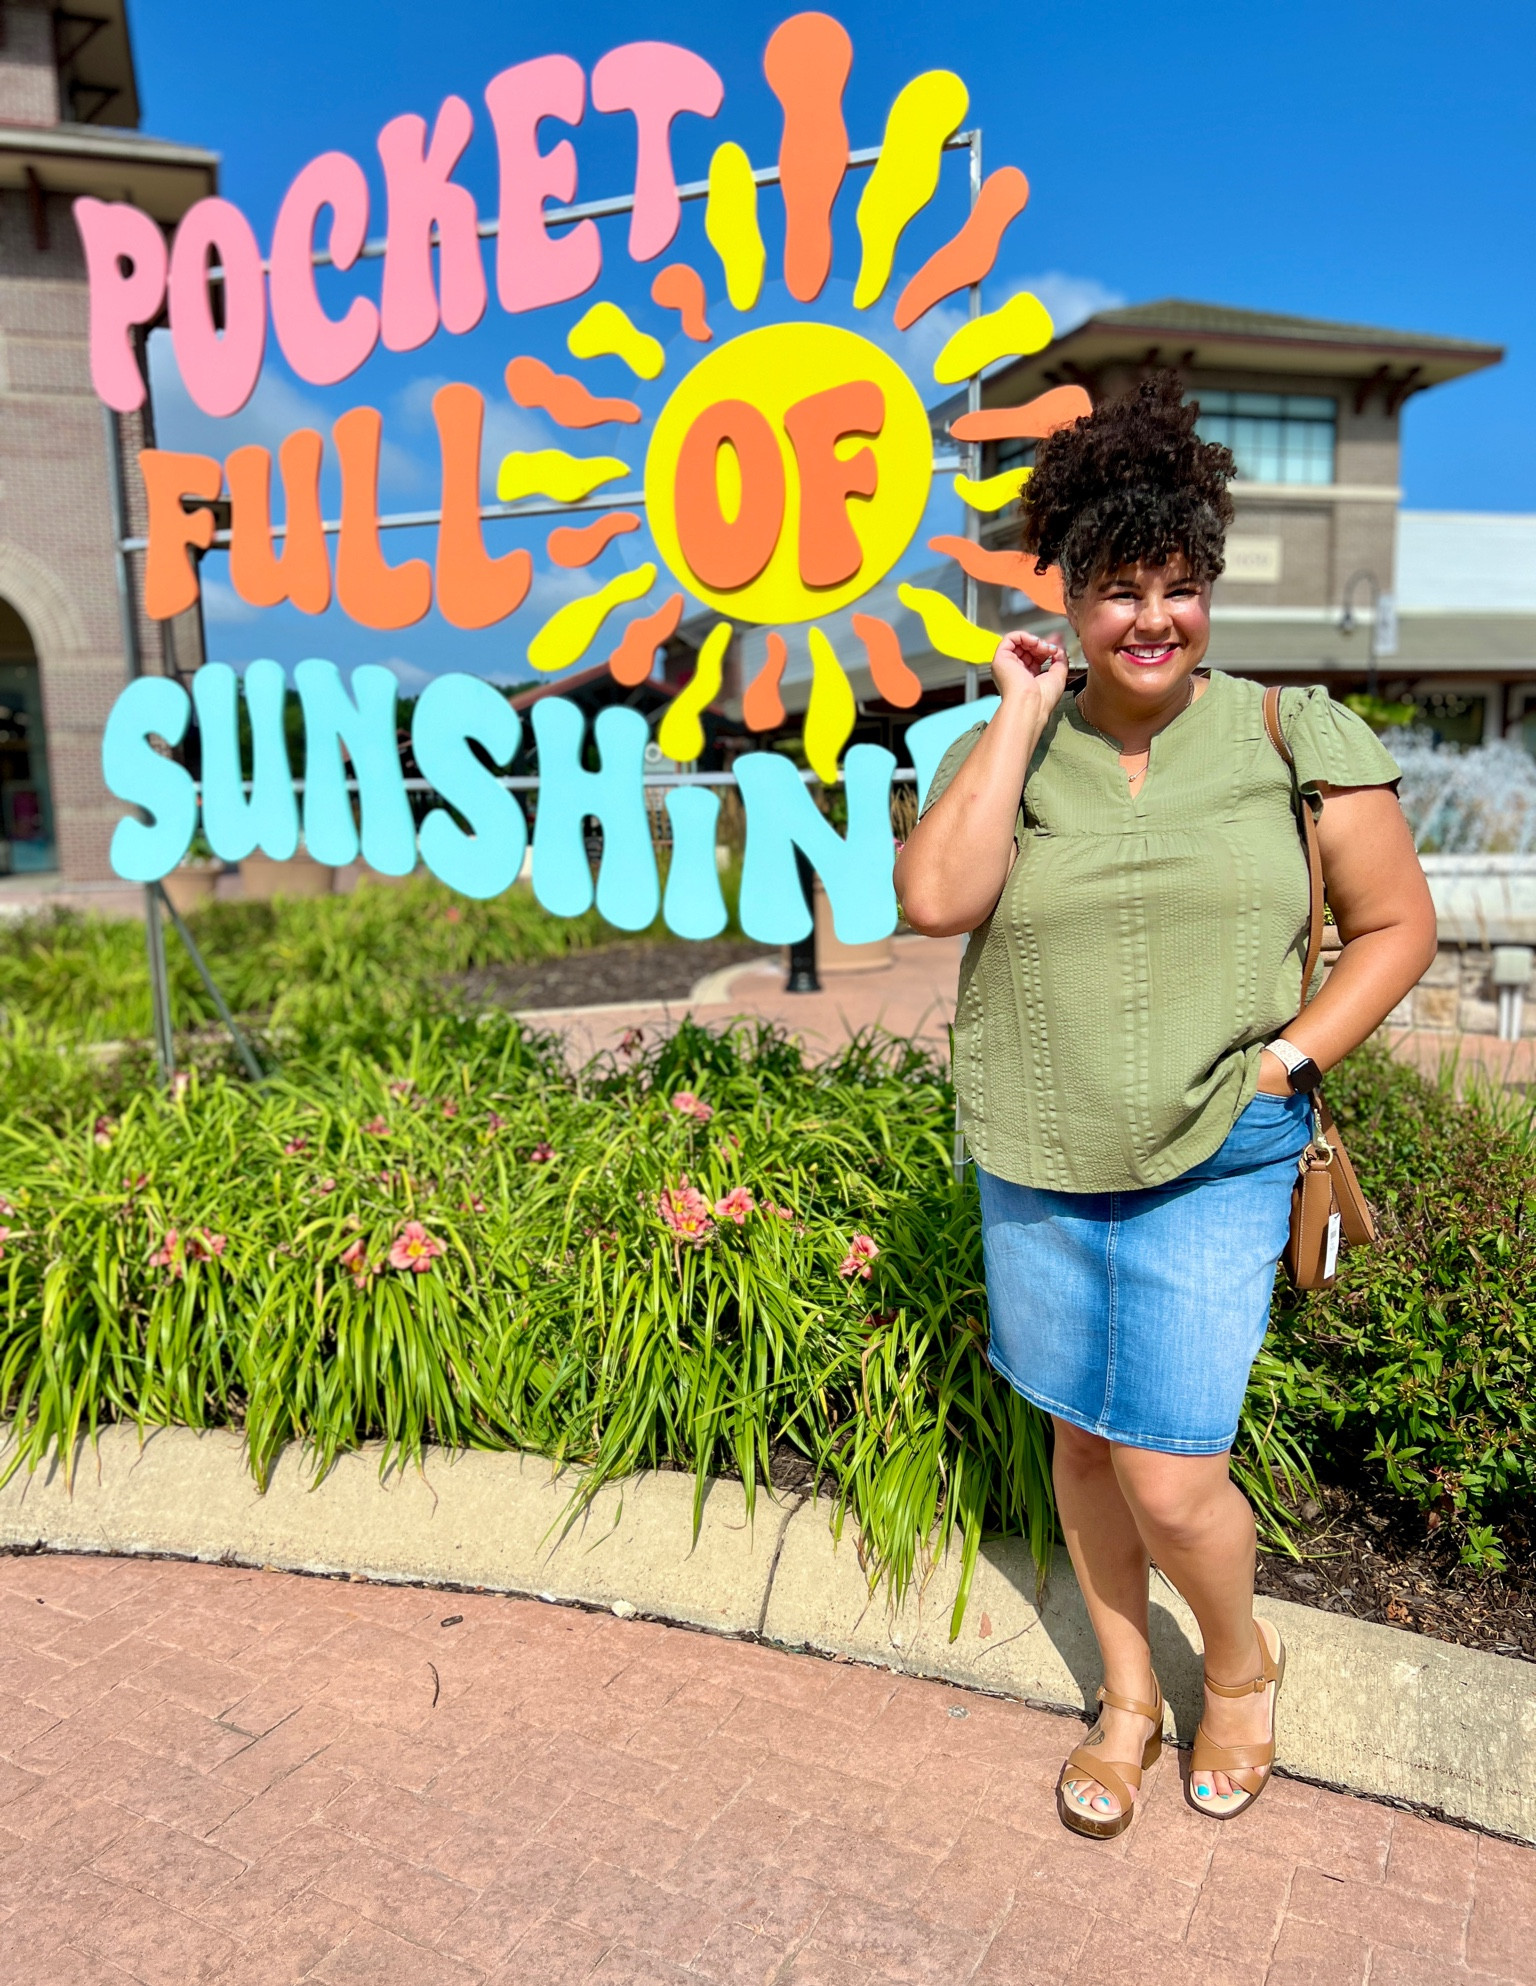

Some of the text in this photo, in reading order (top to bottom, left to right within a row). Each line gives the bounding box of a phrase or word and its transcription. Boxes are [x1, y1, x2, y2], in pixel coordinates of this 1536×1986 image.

[74, 41, 724, 417] POCKET
[138, 380, 885, 630] FULL OF
[102, 658, 1002, 945] SUNSHIN
